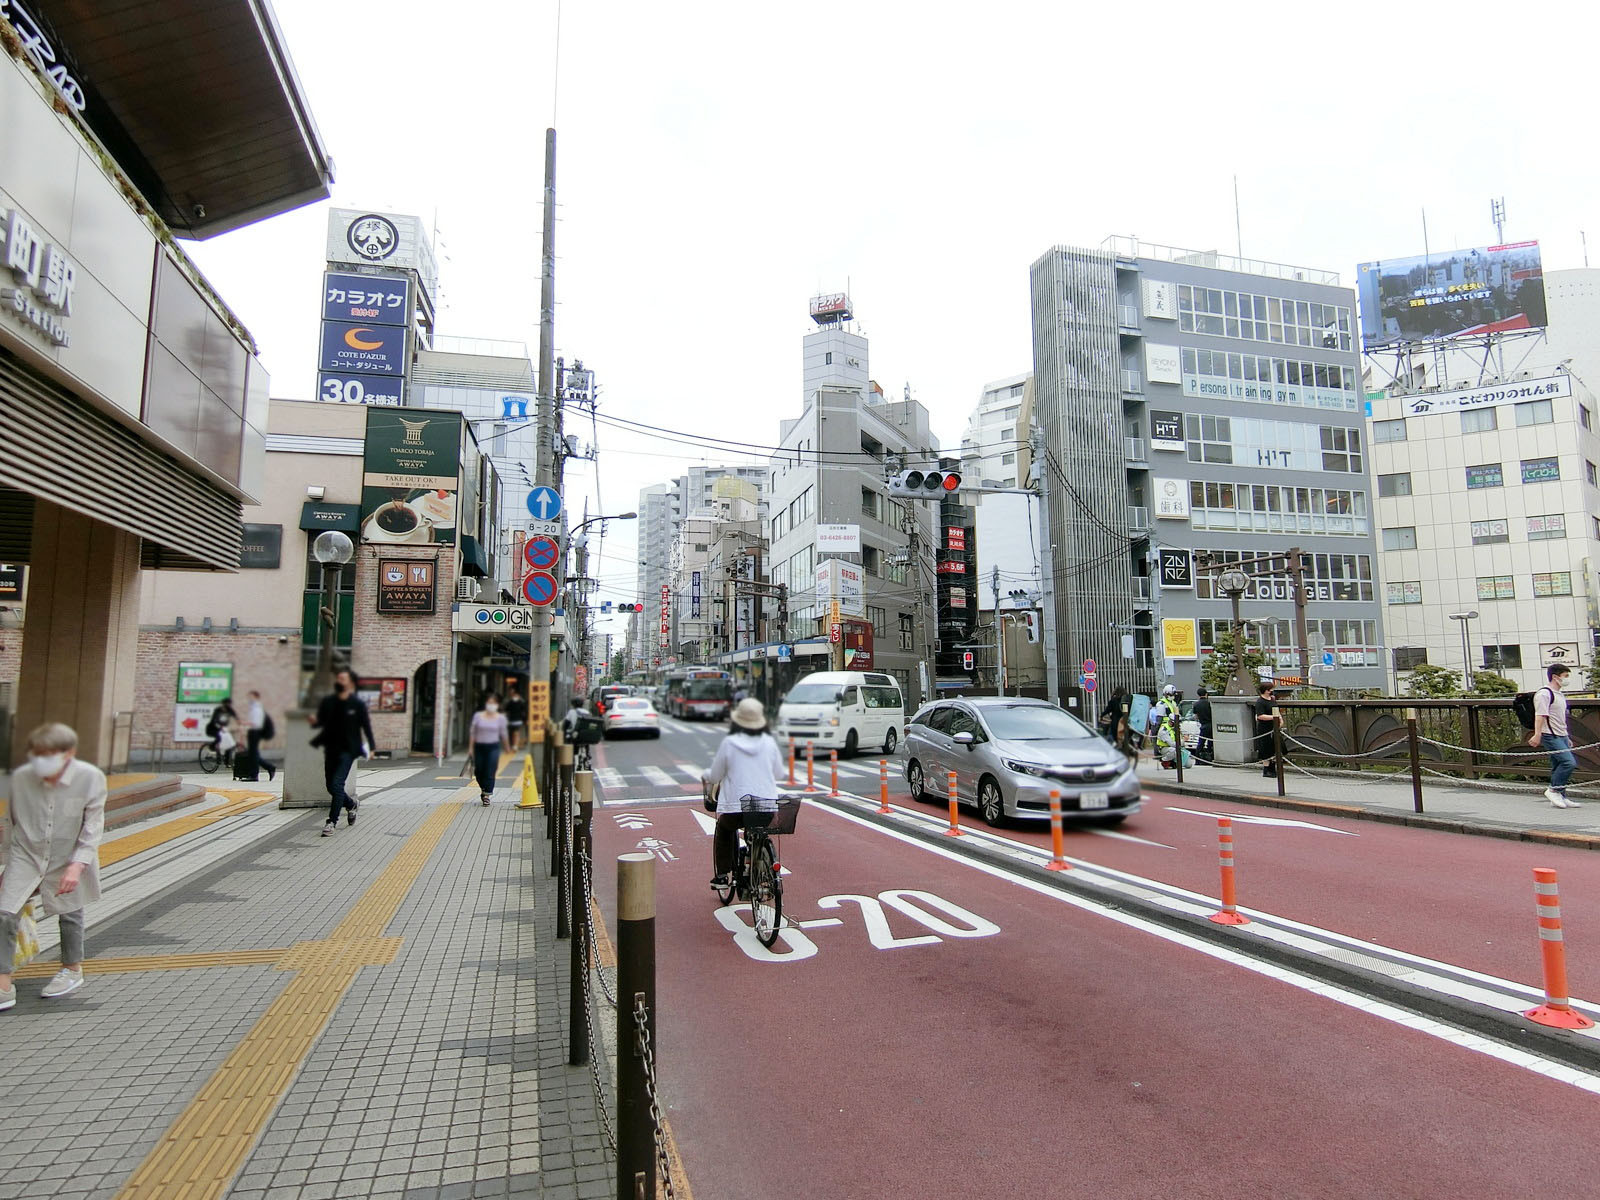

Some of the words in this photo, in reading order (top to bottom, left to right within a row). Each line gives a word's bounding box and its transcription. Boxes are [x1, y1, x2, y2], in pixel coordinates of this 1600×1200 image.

[328, 288, 403, 308] カラオケ
[14, 289, 71, 347] Station
[1191, 379, 1232, 396] Personal
[1236, 384, 1271, 400] training
[1277, 390, 1295, 401] gym
[1459, 383, 1559, 406] こだわりのれん街
[529, 523, 557, 533] 8-20
[386, 592, 427, 600] AWAYA
